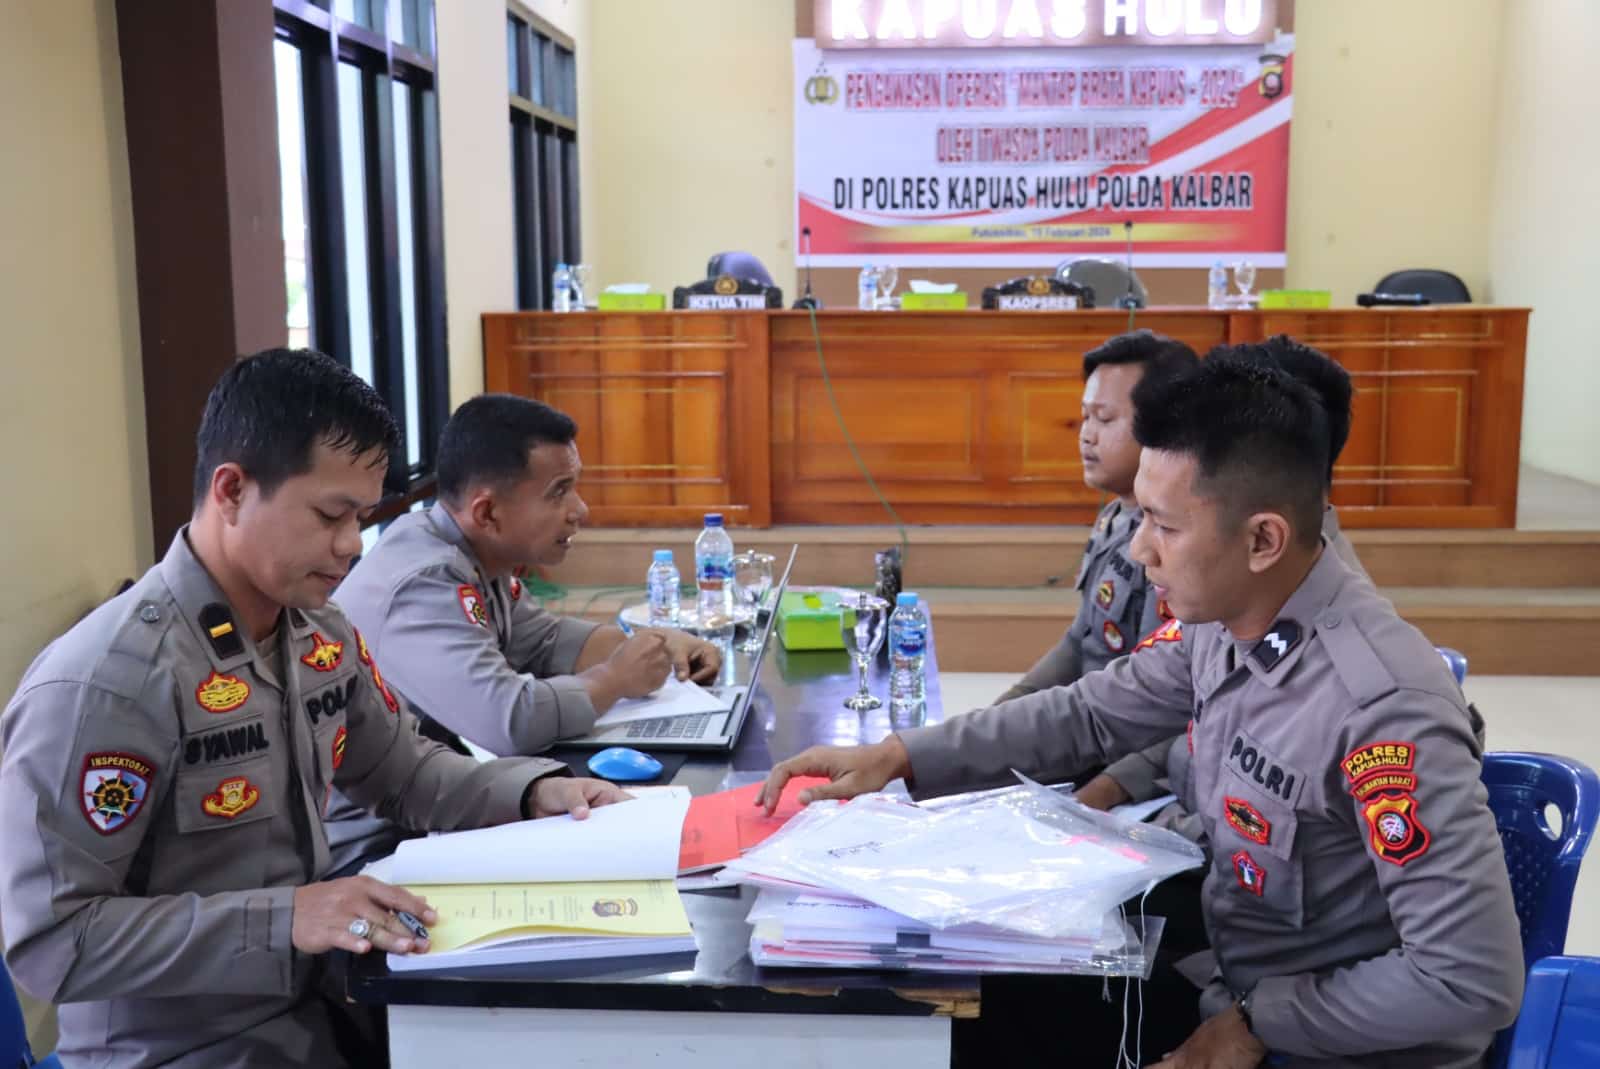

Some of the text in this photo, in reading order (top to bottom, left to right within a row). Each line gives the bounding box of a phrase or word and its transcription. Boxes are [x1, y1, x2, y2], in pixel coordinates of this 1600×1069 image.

[831, 0, 1262, 40] KAPUAS HULU
[936, 125, 974, 165] OLEH
[834, 174, 1252, 209] DI POLRES KAPUAS HULU POLDA KALBAR
[688, 295, 739, 309] KETUA
[90, 756, 151, 774] INSPEKTORAT
[1230, 736, 1295, 800] POLRI
[1345, 745, 1409, 773] POLRES
